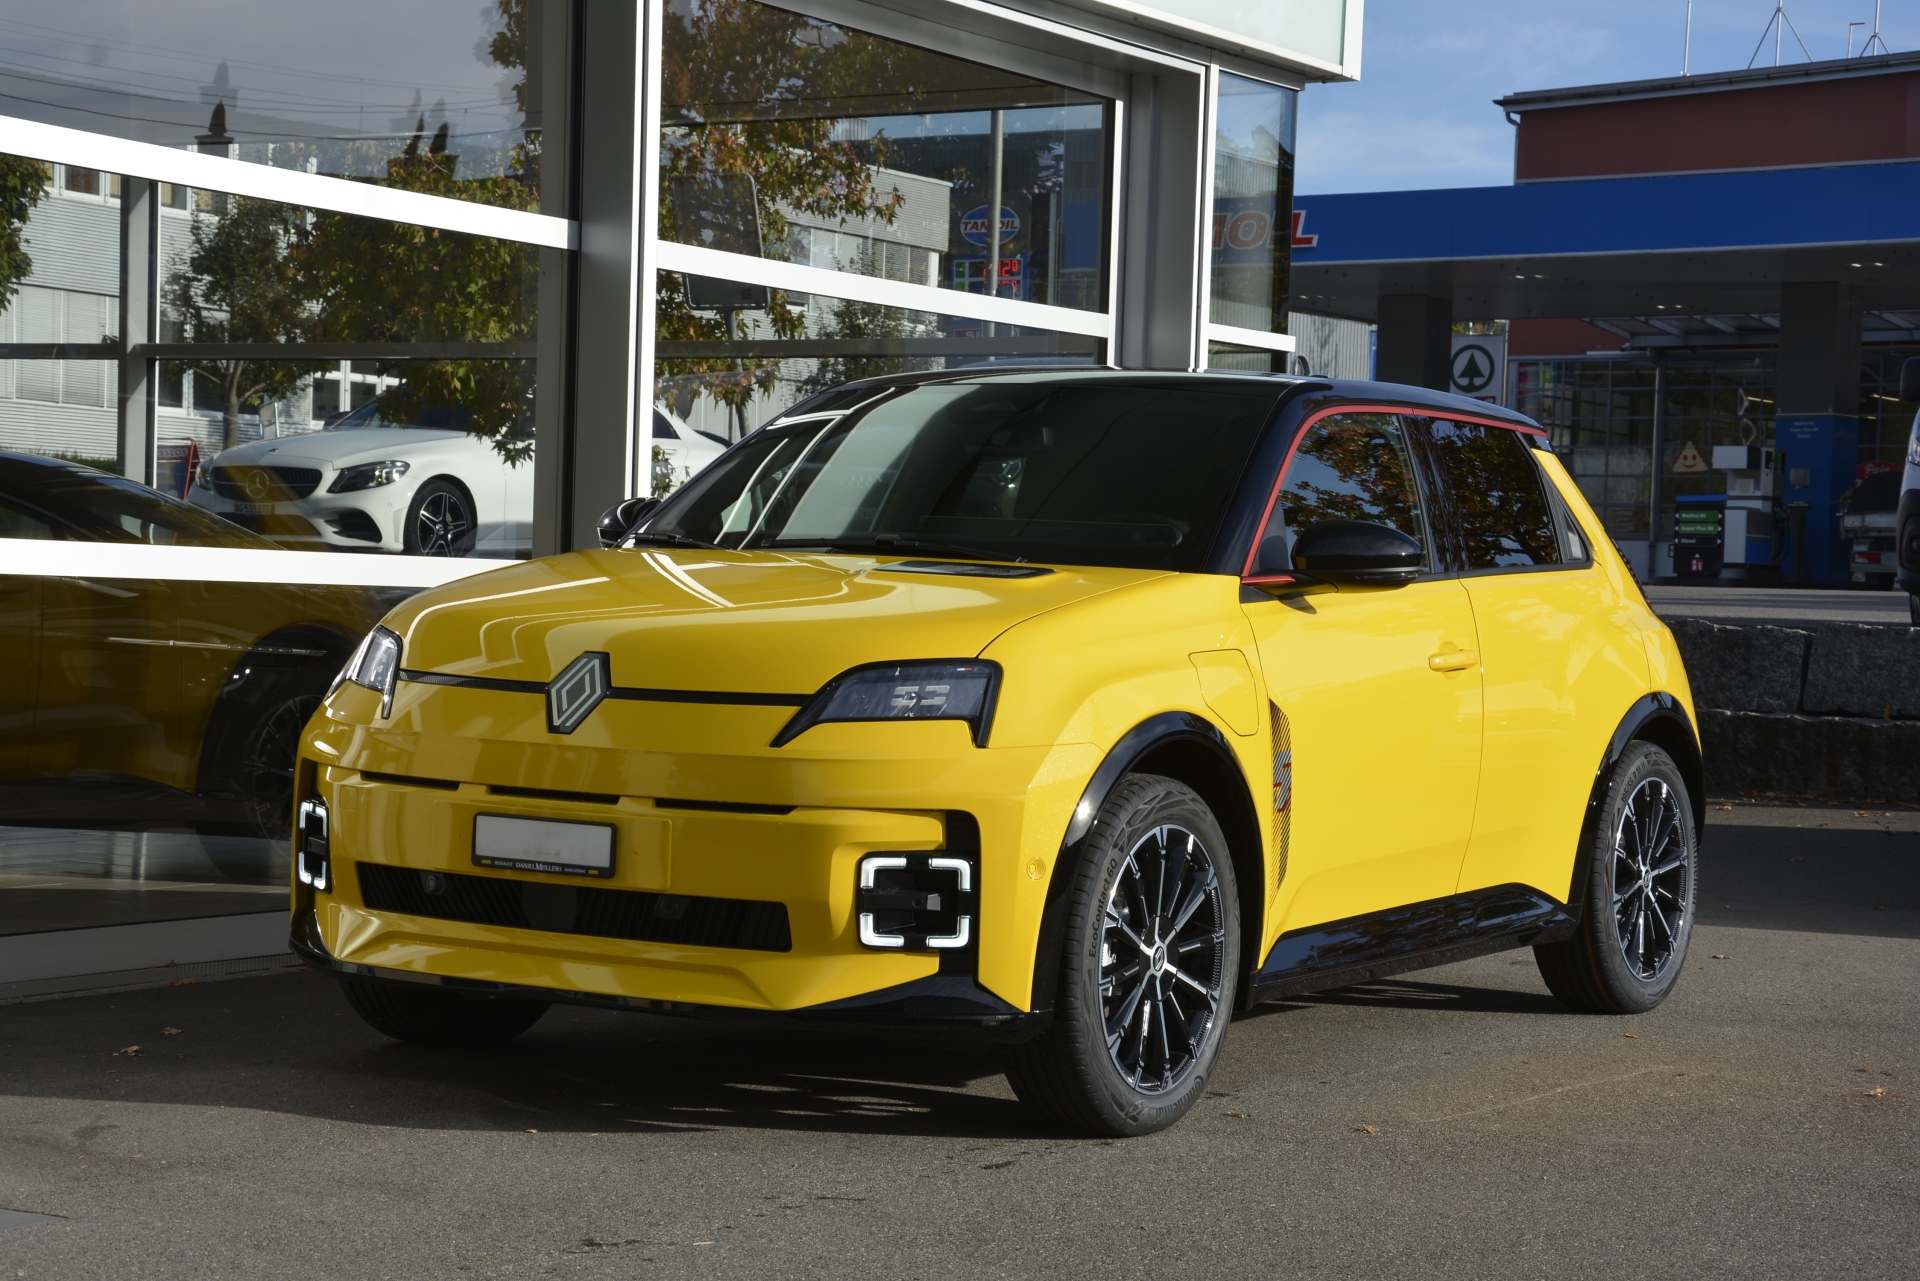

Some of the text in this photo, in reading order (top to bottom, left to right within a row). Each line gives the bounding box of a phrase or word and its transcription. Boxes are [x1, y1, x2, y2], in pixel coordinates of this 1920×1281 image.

[494, 859, 513, 867] RENAULT
[1088, 877, 1110, 957] EcoContact
[1155, 1075, 1204, 1118] Continental
